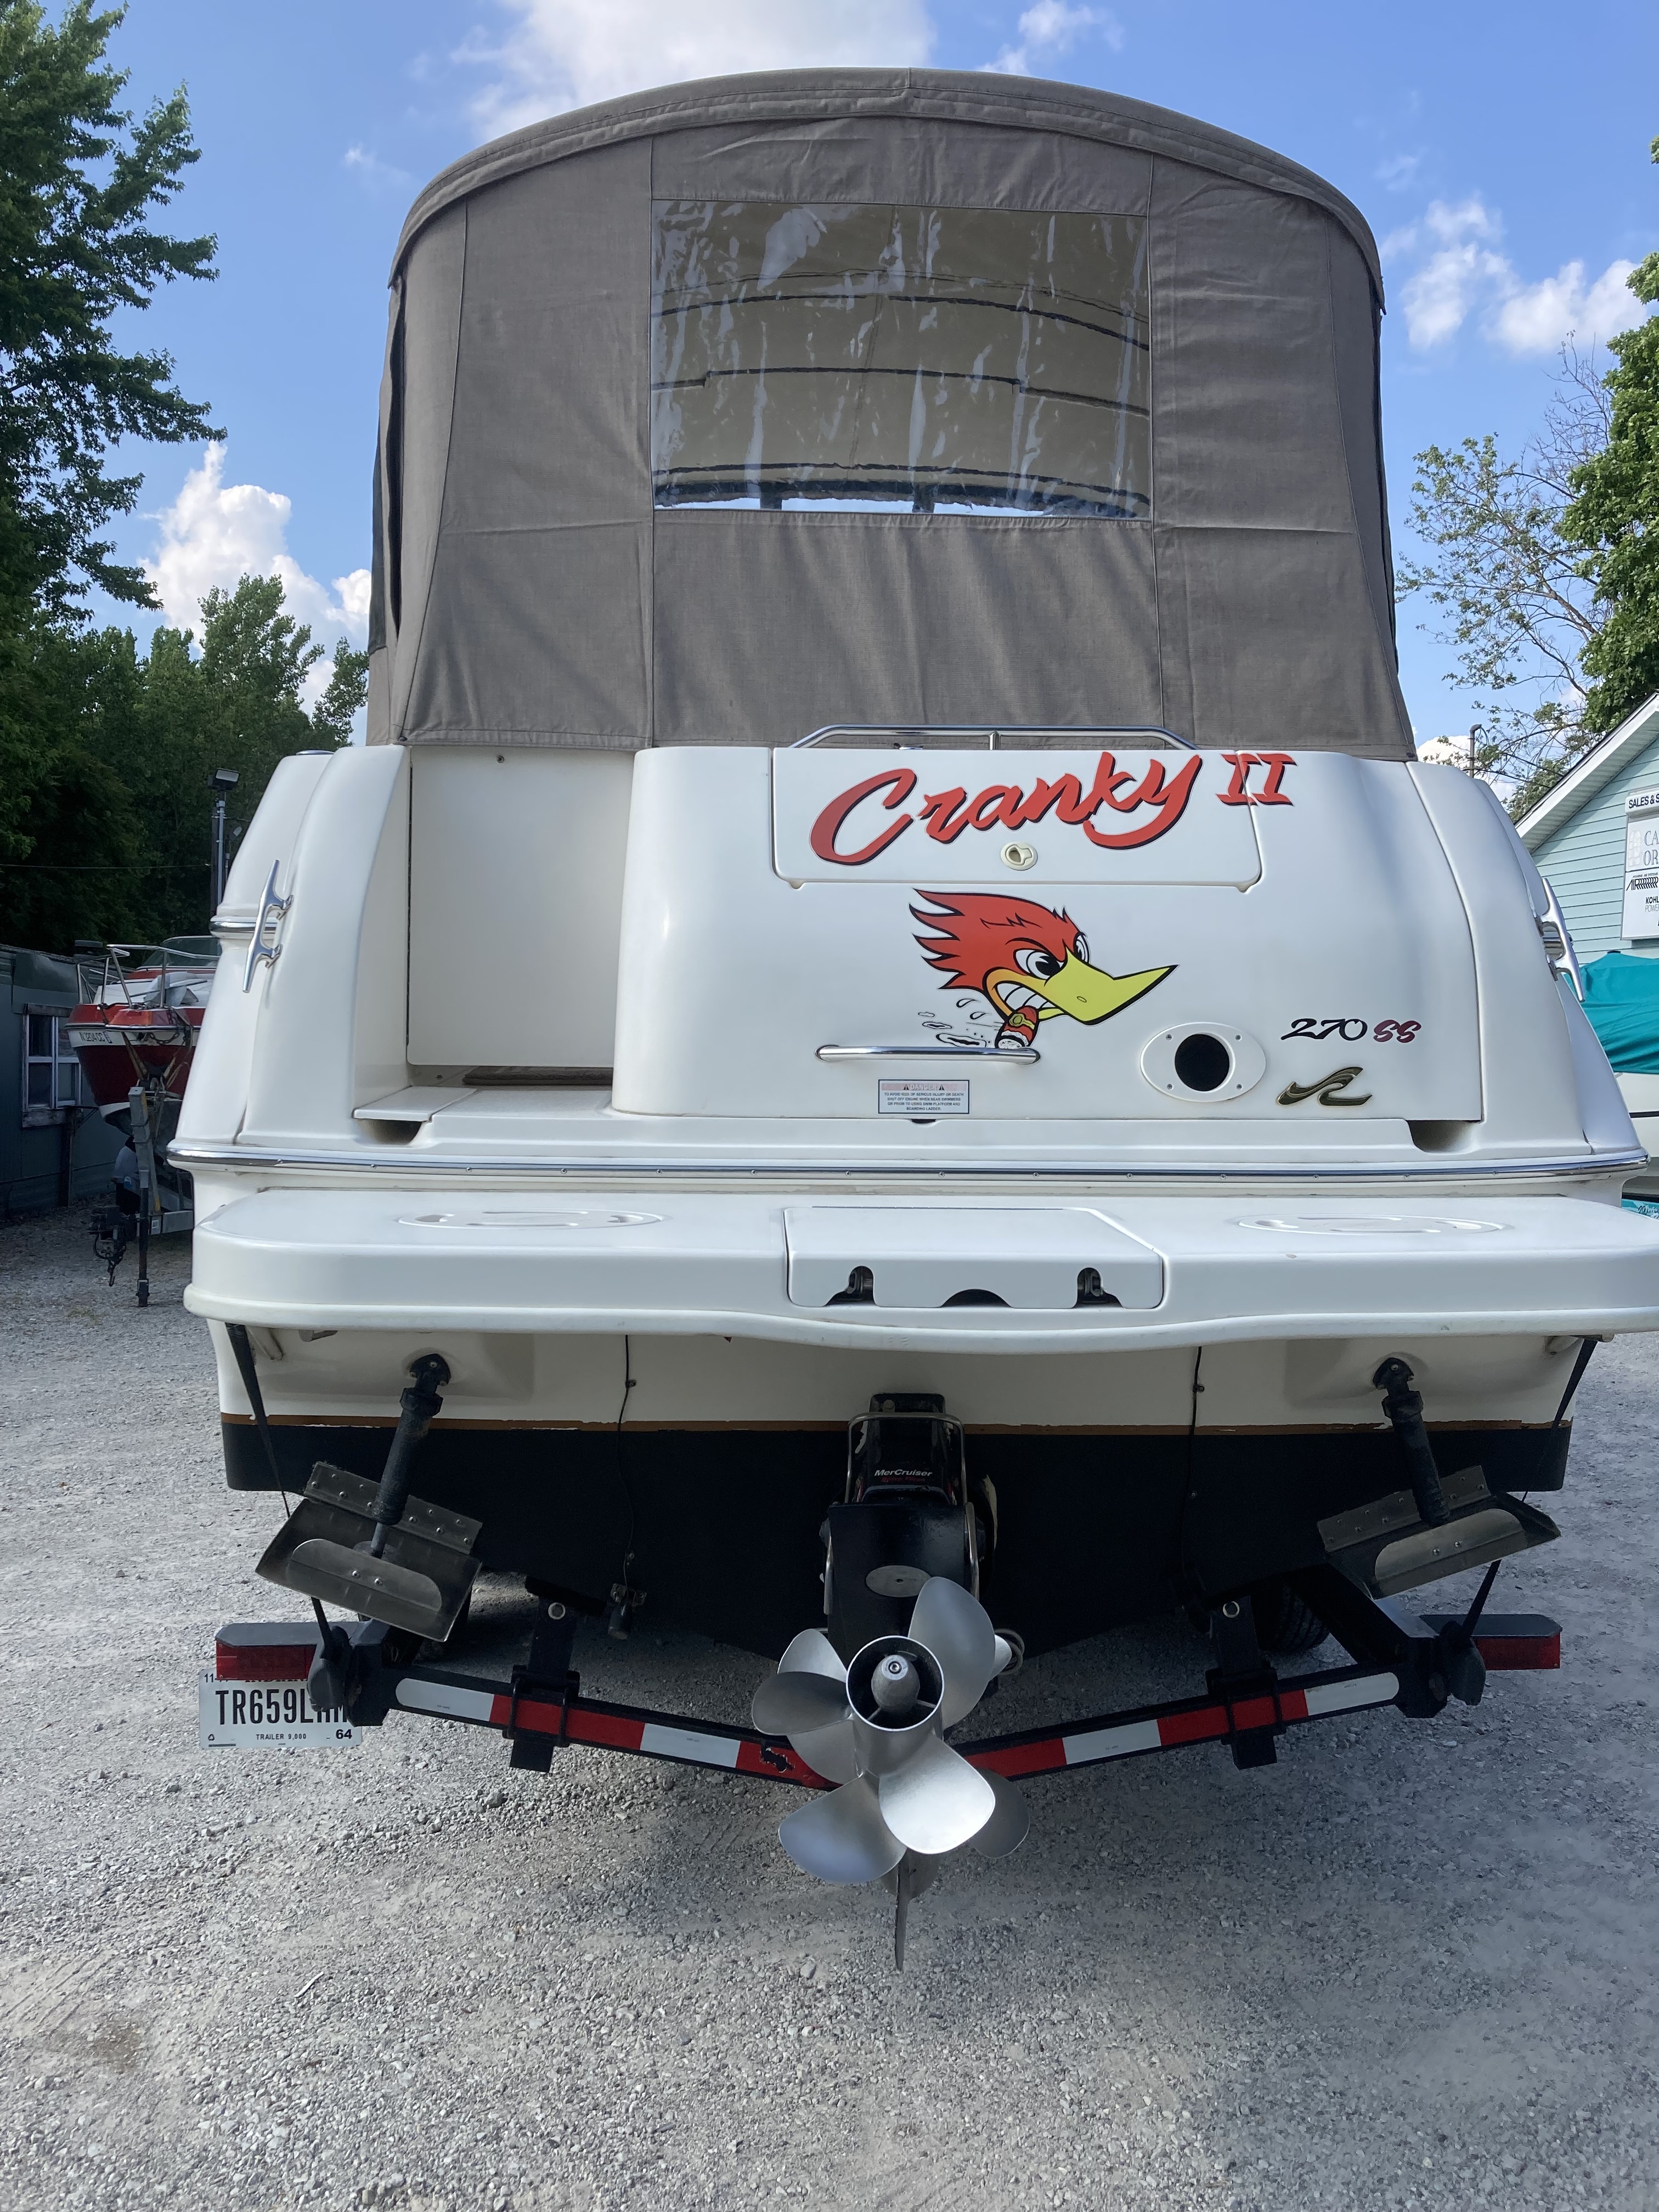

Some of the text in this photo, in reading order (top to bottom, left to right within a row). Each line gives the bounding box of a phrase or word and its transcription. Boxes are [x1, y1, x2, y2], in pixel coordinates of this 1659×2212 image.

[810, 751, 1299, 866] Cranky II
[1628, 796, 1649, 809] SALES
[1650, 794, 1655, 804] &
[1280, 1018, 1422, 1043] 270 SS
[336, 1729, 352, 1739] 64
